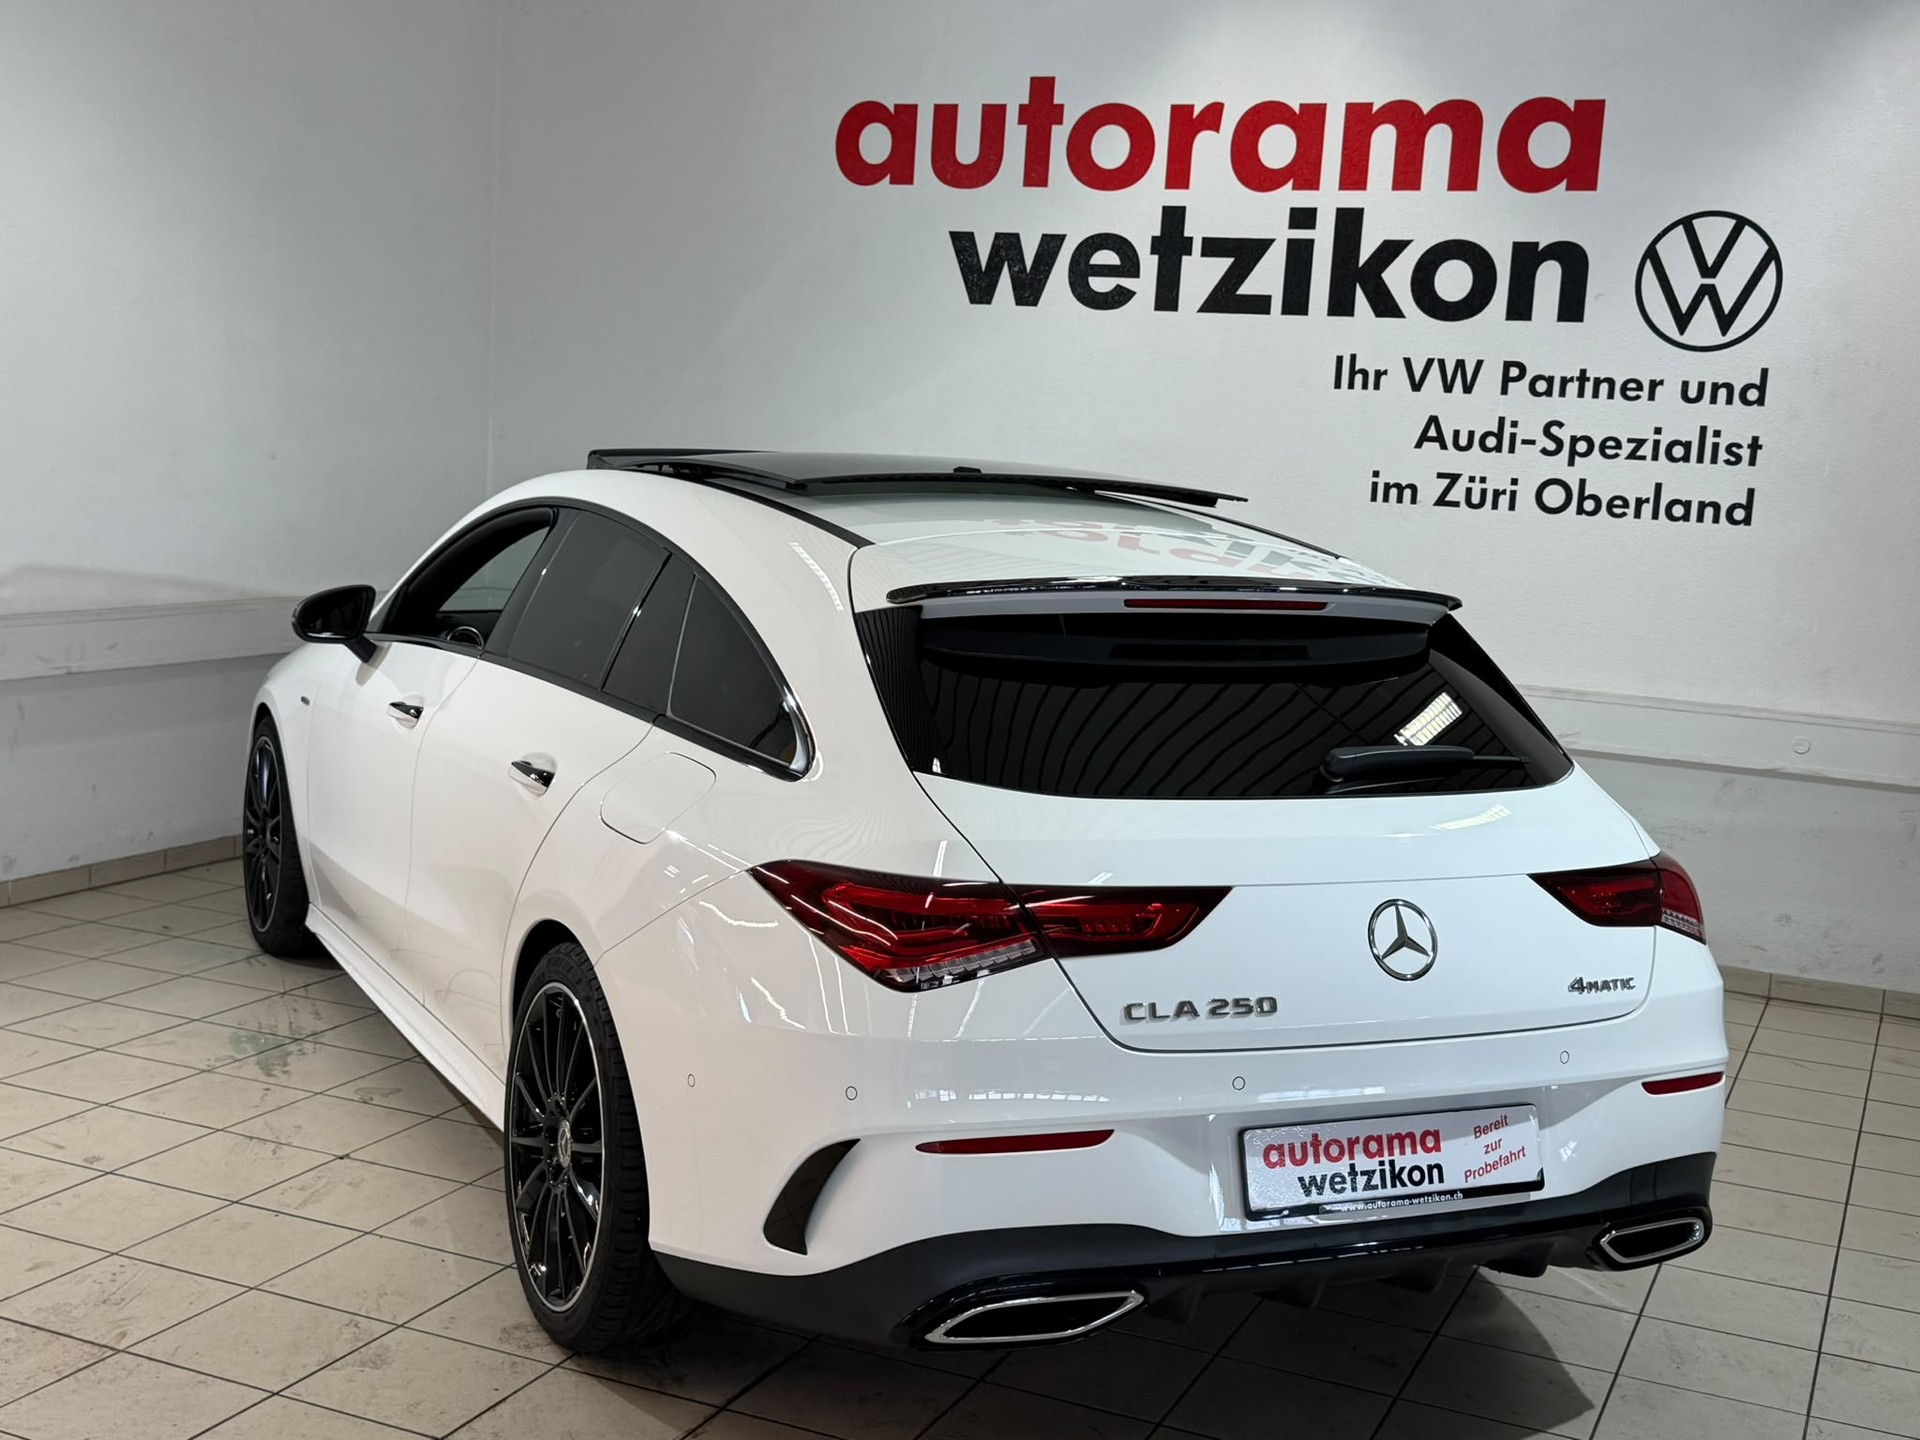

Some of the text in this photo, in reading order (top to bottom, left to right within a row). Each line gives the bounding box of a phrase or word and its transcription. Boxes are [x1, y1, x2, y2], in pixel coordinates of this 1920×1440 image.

[836, 77, 1606, 194] autorama
[948, 205, 1590, 323] wetzikon
[1333, 353, 1769, 407] Ihr VW Partner und
[1413, 414, 1763, 467] Audi-Spezialist
[1370, 470, 1756, 527] im Züri Oberland
[1122, 996, 1278, 1022] CLA 250
[1473, 1114, 1509, 1139] Bereit
[1483, 1137, 1502, 1155] zur
[1262, 1128, 1442, 1170] autorama
[1464, 1145, 1527, 1183] Probefahrt
[1296, 1159, 1445, 1198] wetzikon
[1340, 1190, 1464, 1213] www.autorama-wetzikon.ch
